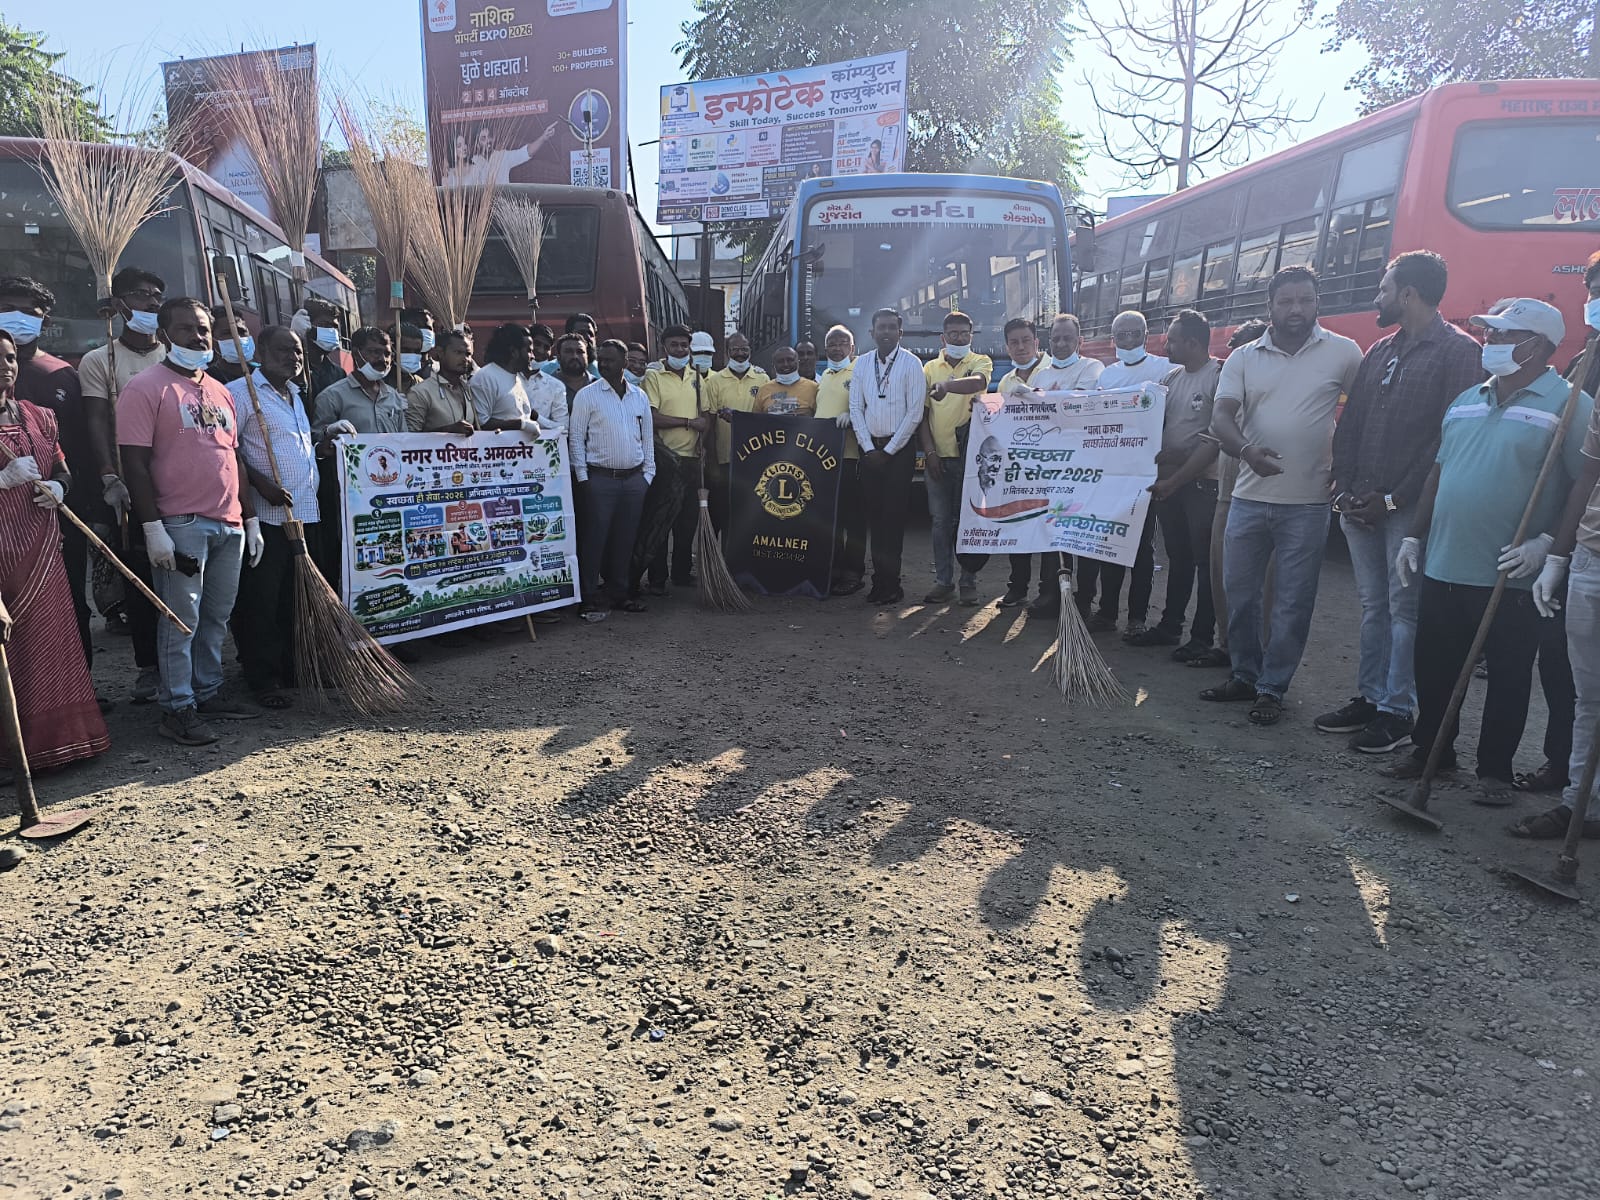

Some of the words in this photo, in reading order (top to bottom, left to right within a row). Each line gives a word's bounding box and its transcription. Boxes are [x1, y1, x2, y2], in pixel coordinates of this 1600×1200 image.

[470, 5, 516, 28] नाशिक
[480, 29, 508, 42] EXPO
[510, 25, 532, 37] 2026
[558, 52, 571, 60] 30+
[572, 46, 607, 58] BUILDERS
[460, 58, 480, 84] धुळे
[484, 57, 521, 78] शहरात
[552, 65, 568, 73] 100+
[570, 57, 614, 71] PROPERTIES
[499, 86, 529, 99] ऑक्टोबर
[704, 75, 826, 125] इन्फोटेक
[832, 61, 896, 83] कॉम्प्युटर
[830, 80, 902, 105] एज्युकेशन
[729, 115, 749, 128] Skill
[752, 115, 781, 127] Today,
[786, 110, 826, 121] Success
[828, 102, 877, 115] Tomorrow
[734, 203, 748, 211] CLASS
[892, 200, 974, 218] નર્મદા
[818, 211, 862, 223] ગુજરાત
[401, 448, 432, 464] नगर
[435, 443, 482, 463] परिषद,
[484, 441, 534, 461] अमळनेर
[737, 430, 785, 461] LIONS
[795, 432, 837, 470] CLUB
[1008, 447, 1076, 462] स्वच्छता
[767, 463, 803, 479] LIONS
[1004, 462, 1022, 482] ही
[1025, 464, 1062, 481] सेवा
[777, 479, 793, 499] L
[386, 495, 414, 505] स्वच्छता
[416, 492, 424, 504] ही
[1055, 514, 1129, 538] स्वच्छोत्सव
[752, 535, 808, 550] AMALNER
